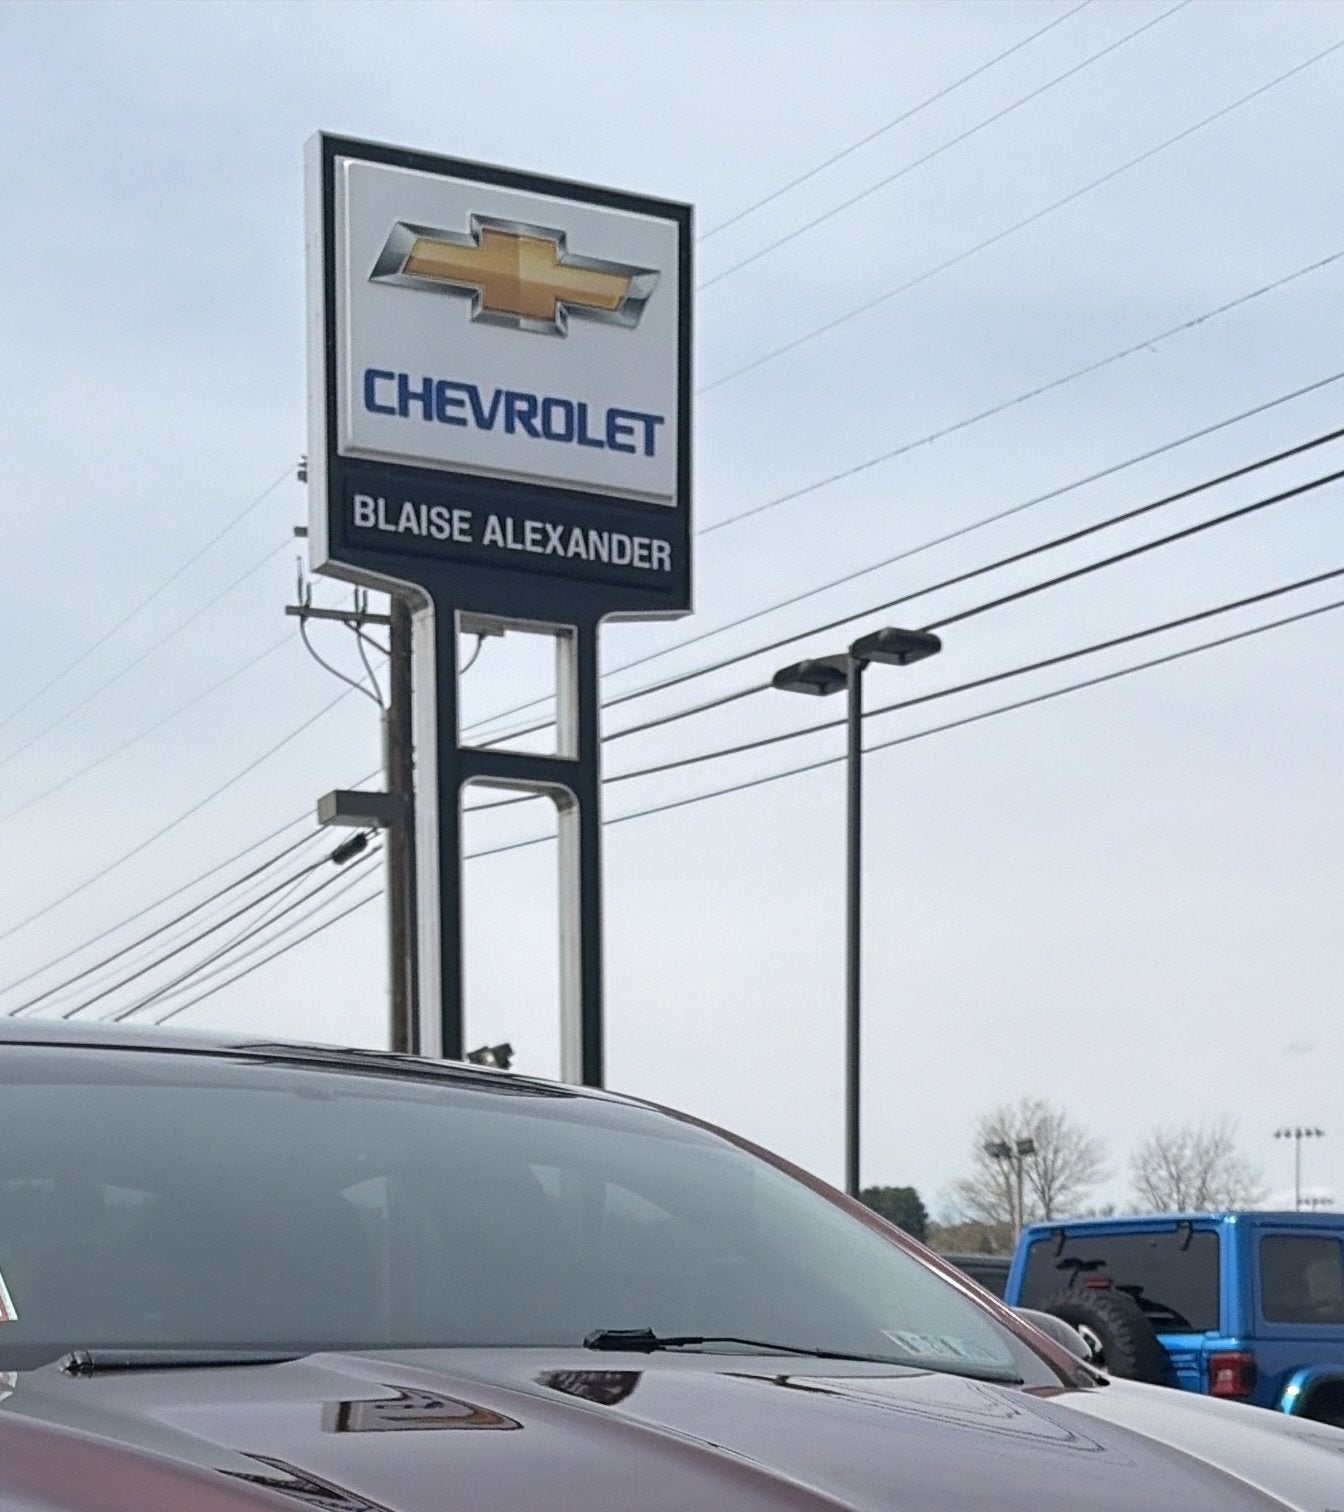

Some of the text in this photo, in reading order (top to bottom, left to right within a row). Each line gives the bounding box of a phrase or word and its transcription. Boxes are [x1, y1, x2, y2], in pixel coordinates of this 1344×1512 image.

[363, 368, 664, 457] CHEVROLET
[353, 494, 673, 572] BLAISE ALEXANDER
